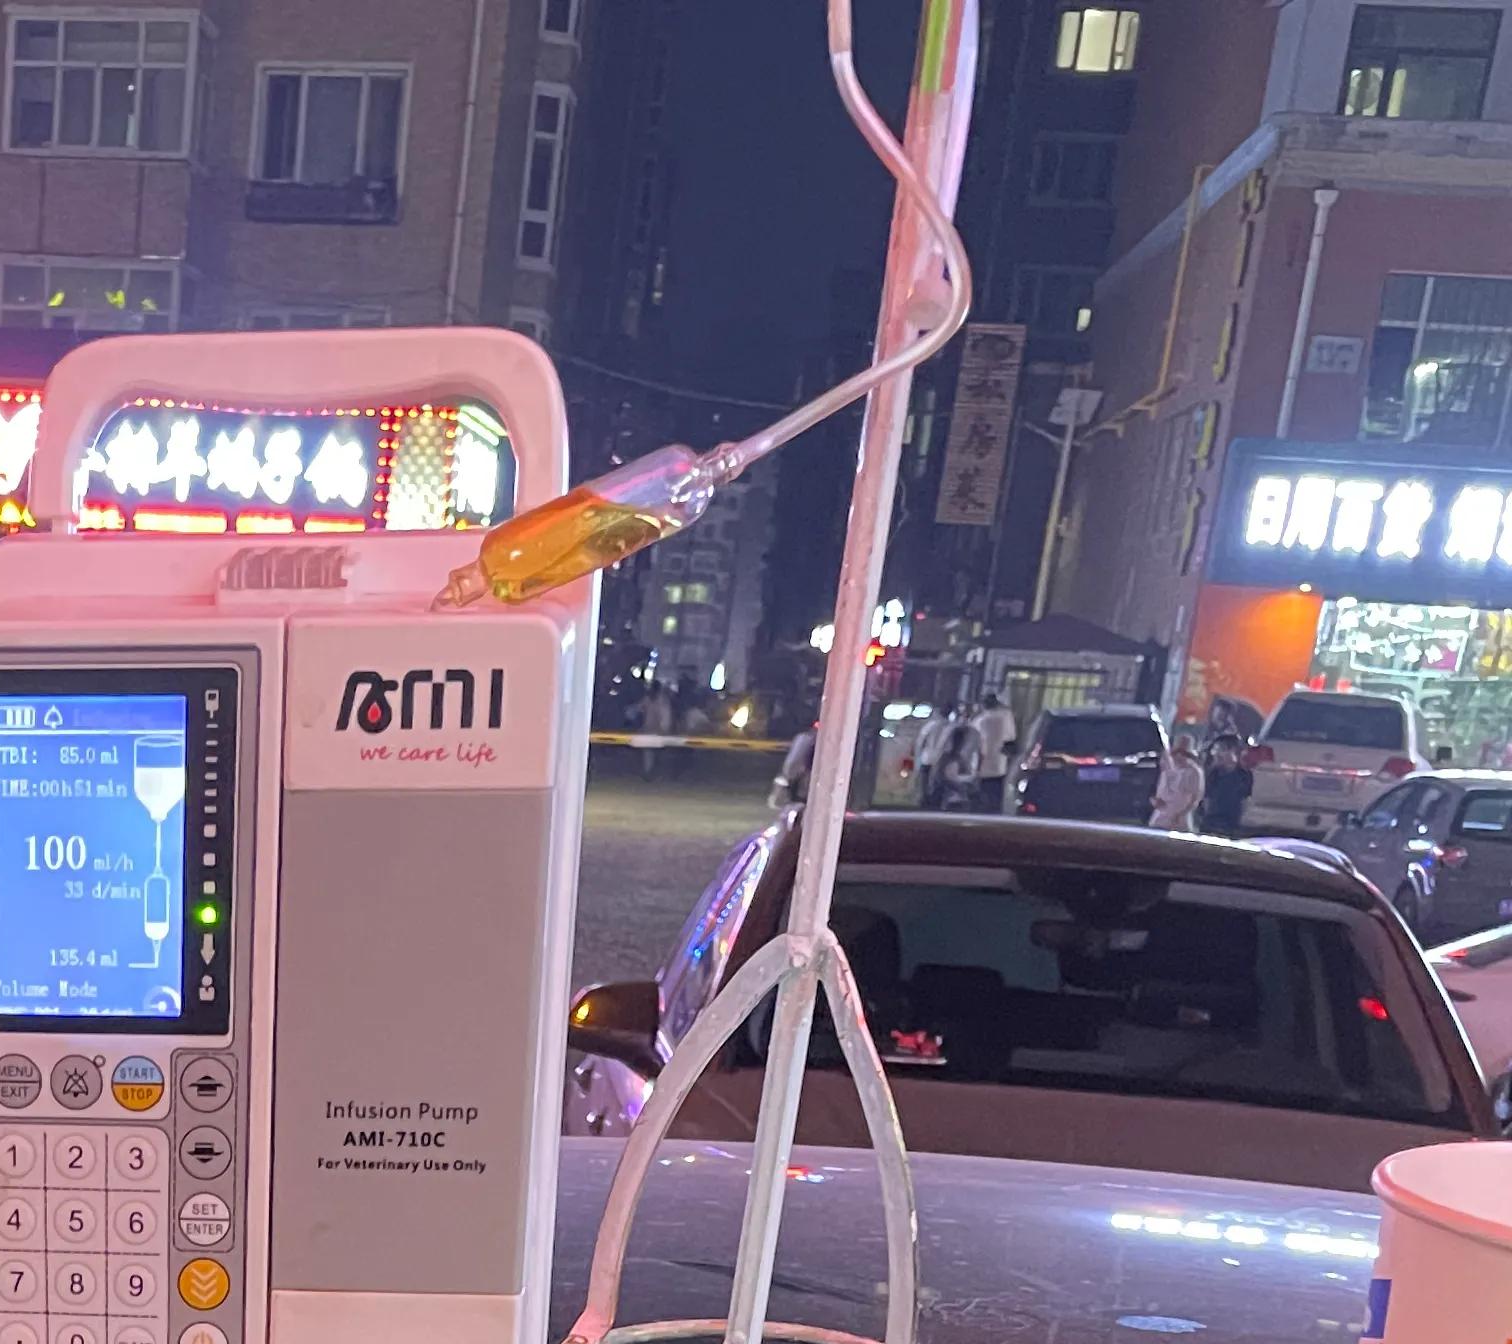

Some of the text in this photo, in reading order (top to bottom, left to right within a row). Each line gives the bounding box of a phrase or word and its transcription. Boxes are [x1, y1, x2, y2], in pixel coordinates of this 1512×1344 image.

[360, 743, 498, 768] we care life
[24, 835, 134, 872] 100 ml/h
[64, 881, 141, 900] 33 d/min
[49, 949, 95, 967] 135.4
[59, 980, 98, 998] Mode
[119, 1066, 156, 1080] START
[0, 1086, 30, 1098] EXIT
[121, 1088, 154, 1100] STOP
[325, 1100, 479, 1125] Infusion Pump
[343, 1131, 447, 1148] AMI-710C
[7, 1145, 17, 1167] 1
[68, 1146, 83, 1169] 2
[128, 1147, 144, 1170] 3
[317, 1157, 487, 1175] For Veterinary Use Only
[7, 1209, 21, 1231] 4
[191, 1203, 219, 1215] SET
[68, 1210, 84, 1232] 5
[128, 1211, 144, 1234] 6
[187, 1223, 224, 1236] ENTER
[9, 1271, 24, 1293] 7
[69, 1272, 85, 1296] 8
[128, 1274, 144, 1297] 9
